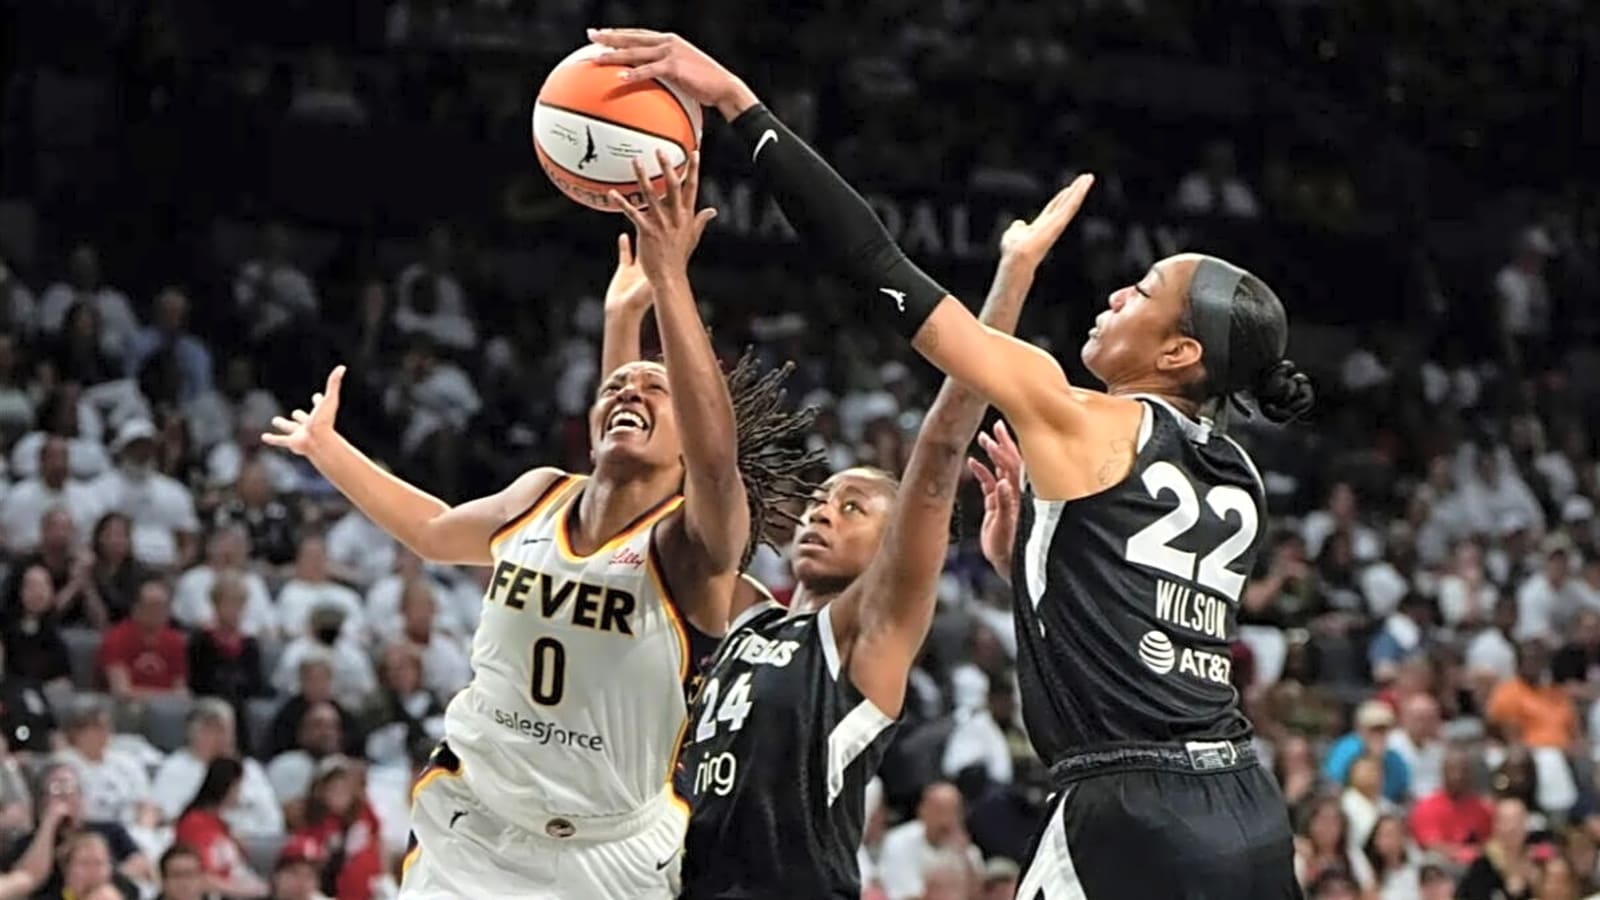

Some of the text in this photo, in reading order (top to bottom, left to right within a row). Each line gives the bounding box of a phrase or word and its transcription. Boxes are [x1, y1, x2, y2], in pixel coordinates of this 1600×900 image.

[609, 547, 645, 570] Lilly
[1125, 460, 1259, 602] 22
[489, 559, 636, 636] FEVER
[1156, 579, 1227, 640] WILSON
[531, 636, 566, 707] 0
[495, 708, 604, 752] salesforce
[695, 671, 753, 743] 24
[693, 751, 737, 796] ring
